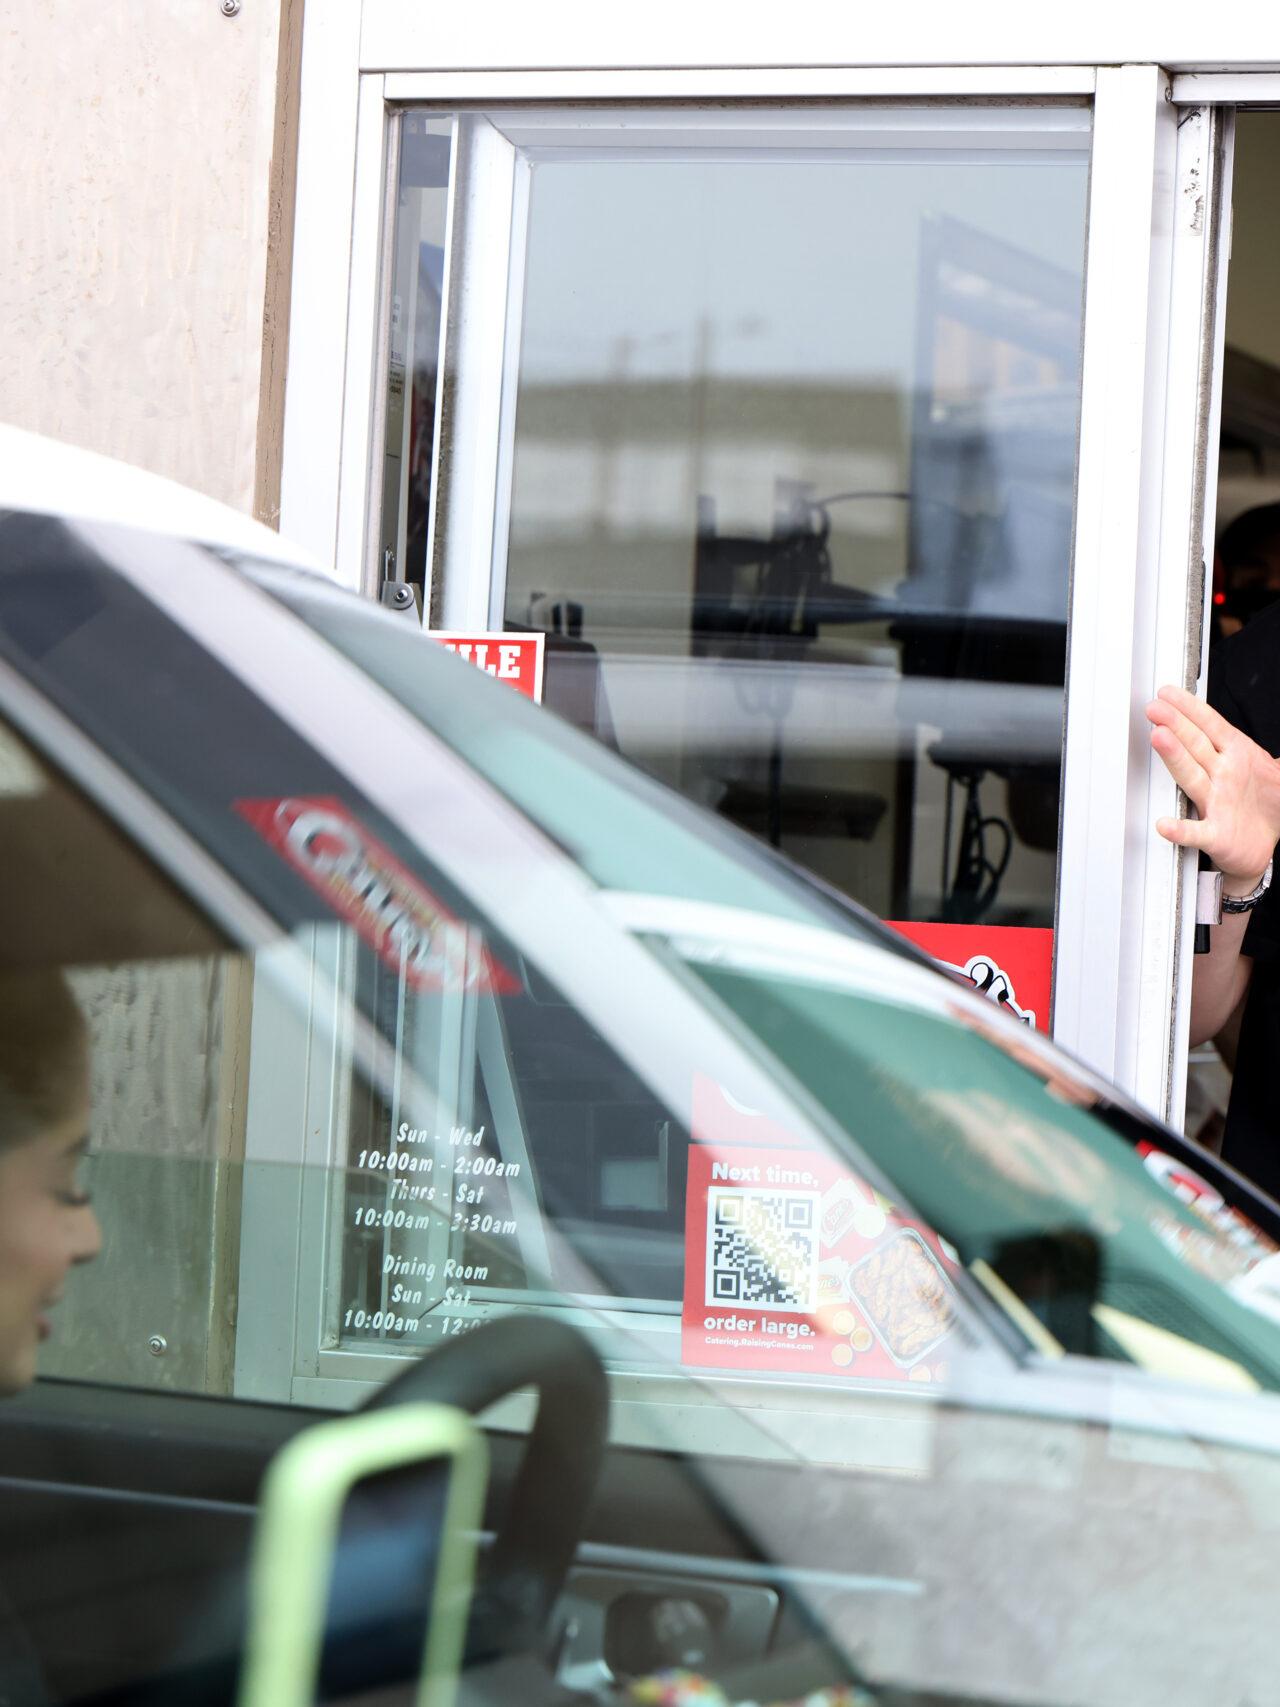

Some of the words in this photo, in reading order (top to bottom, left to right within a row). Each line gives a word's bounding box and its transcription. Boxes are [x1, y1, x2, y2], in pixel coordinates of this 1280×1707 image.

[397, 1122, 427, 1144] Sun
[450, 1126, 485, 1147] Wed
[358, 1150, 434, 1172] 10:00am
[454, 1157, 520, 1177] 2:00am
[712, 1162, 760, 1182] Next
[766, 1164, 820, 1188] time,
[390, 1178, 436, 1201] Thurs
[456, 1183, 484, 1204] Sat
[354, 1208, 430, 1230] 10:00am
[382, 1254, 436, 1282] Dining
[444, 1258, 490, 1280] Room
[391, 1284, 422, 1304] Sun
[443, 1286, 471, 1308] Sat
[344, 1310, 419, 1332] 10:00am
[704, 1314, 756, 1332] order
[761, 1316, 816, 1339] large.
[704, 1336, 814, 1352] Catering.RaisingCanes.com
